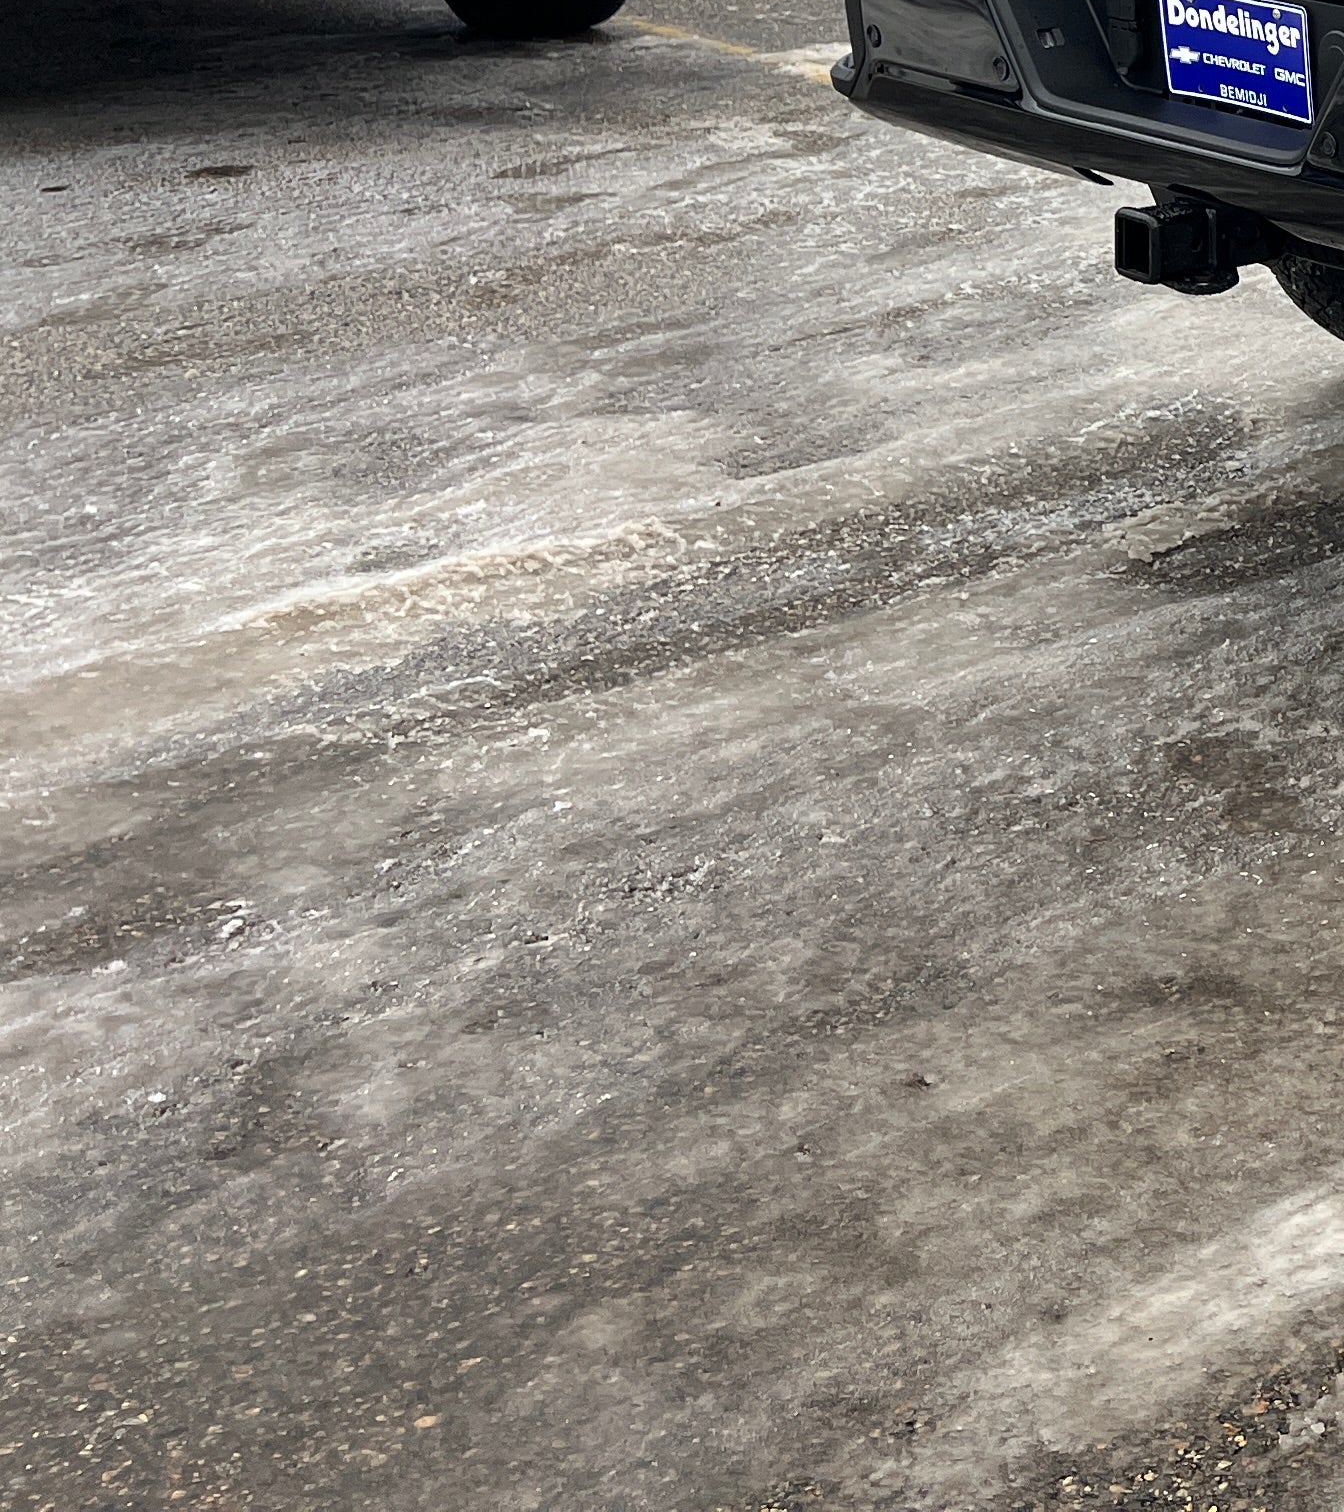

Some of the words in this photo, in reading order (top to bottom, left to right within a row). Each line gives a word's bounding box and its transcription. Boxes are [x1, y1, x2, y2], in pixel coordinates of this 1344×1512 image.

[1202, 52, 1266, 76] CHEVROLET
[1274, 67, 1306, 87] GMC
[1219, 83, 1268, 107] BEMIDJI
